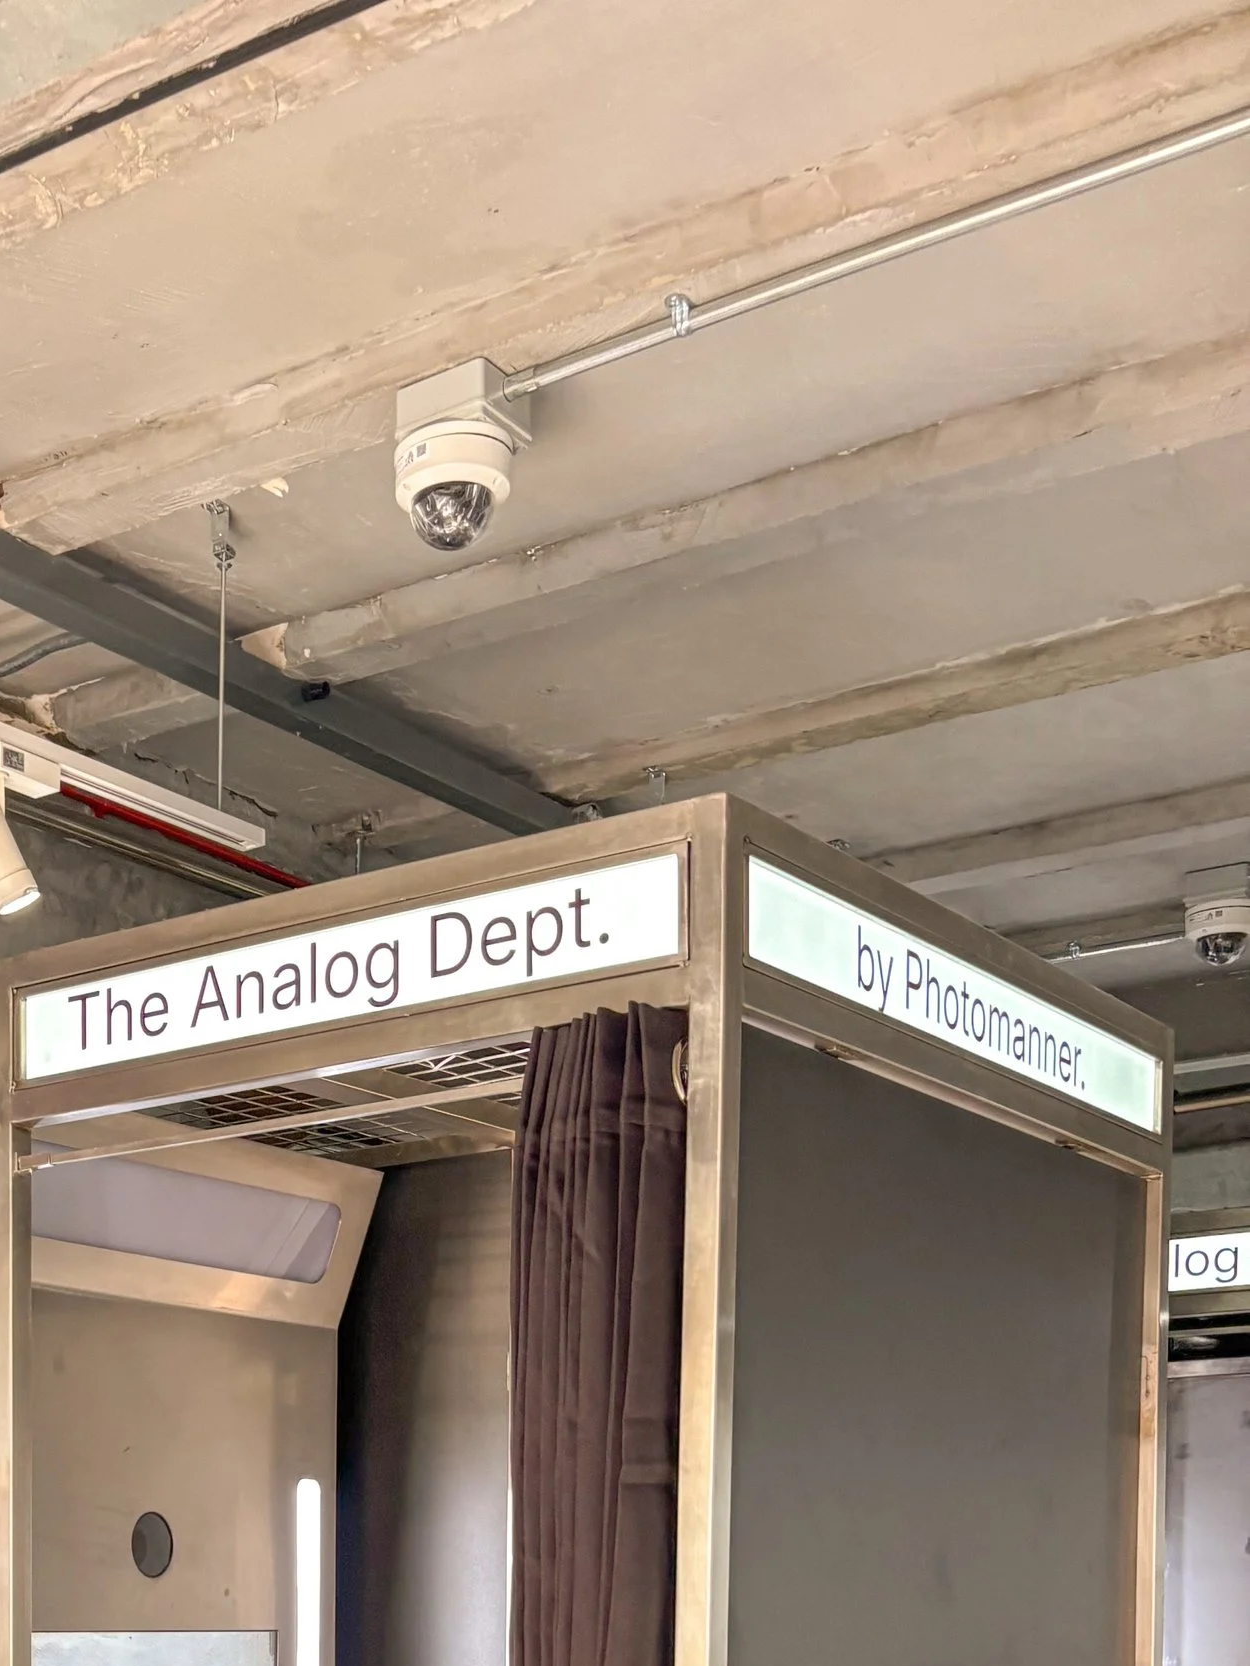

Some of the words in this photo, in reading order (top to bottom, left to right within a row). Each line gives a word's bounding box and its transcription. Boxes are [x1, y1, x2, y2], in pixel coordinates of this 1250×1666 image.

[68, 987, 169, 1050] The
[190, 939, 400, 1028] Analog
[430, 888, 610, 977] Dept.
[857, 925, 893, 1013] by
[906, 949, 1086, 1091] Photomanner.
[1174, 1244, 1239, 1283] log
